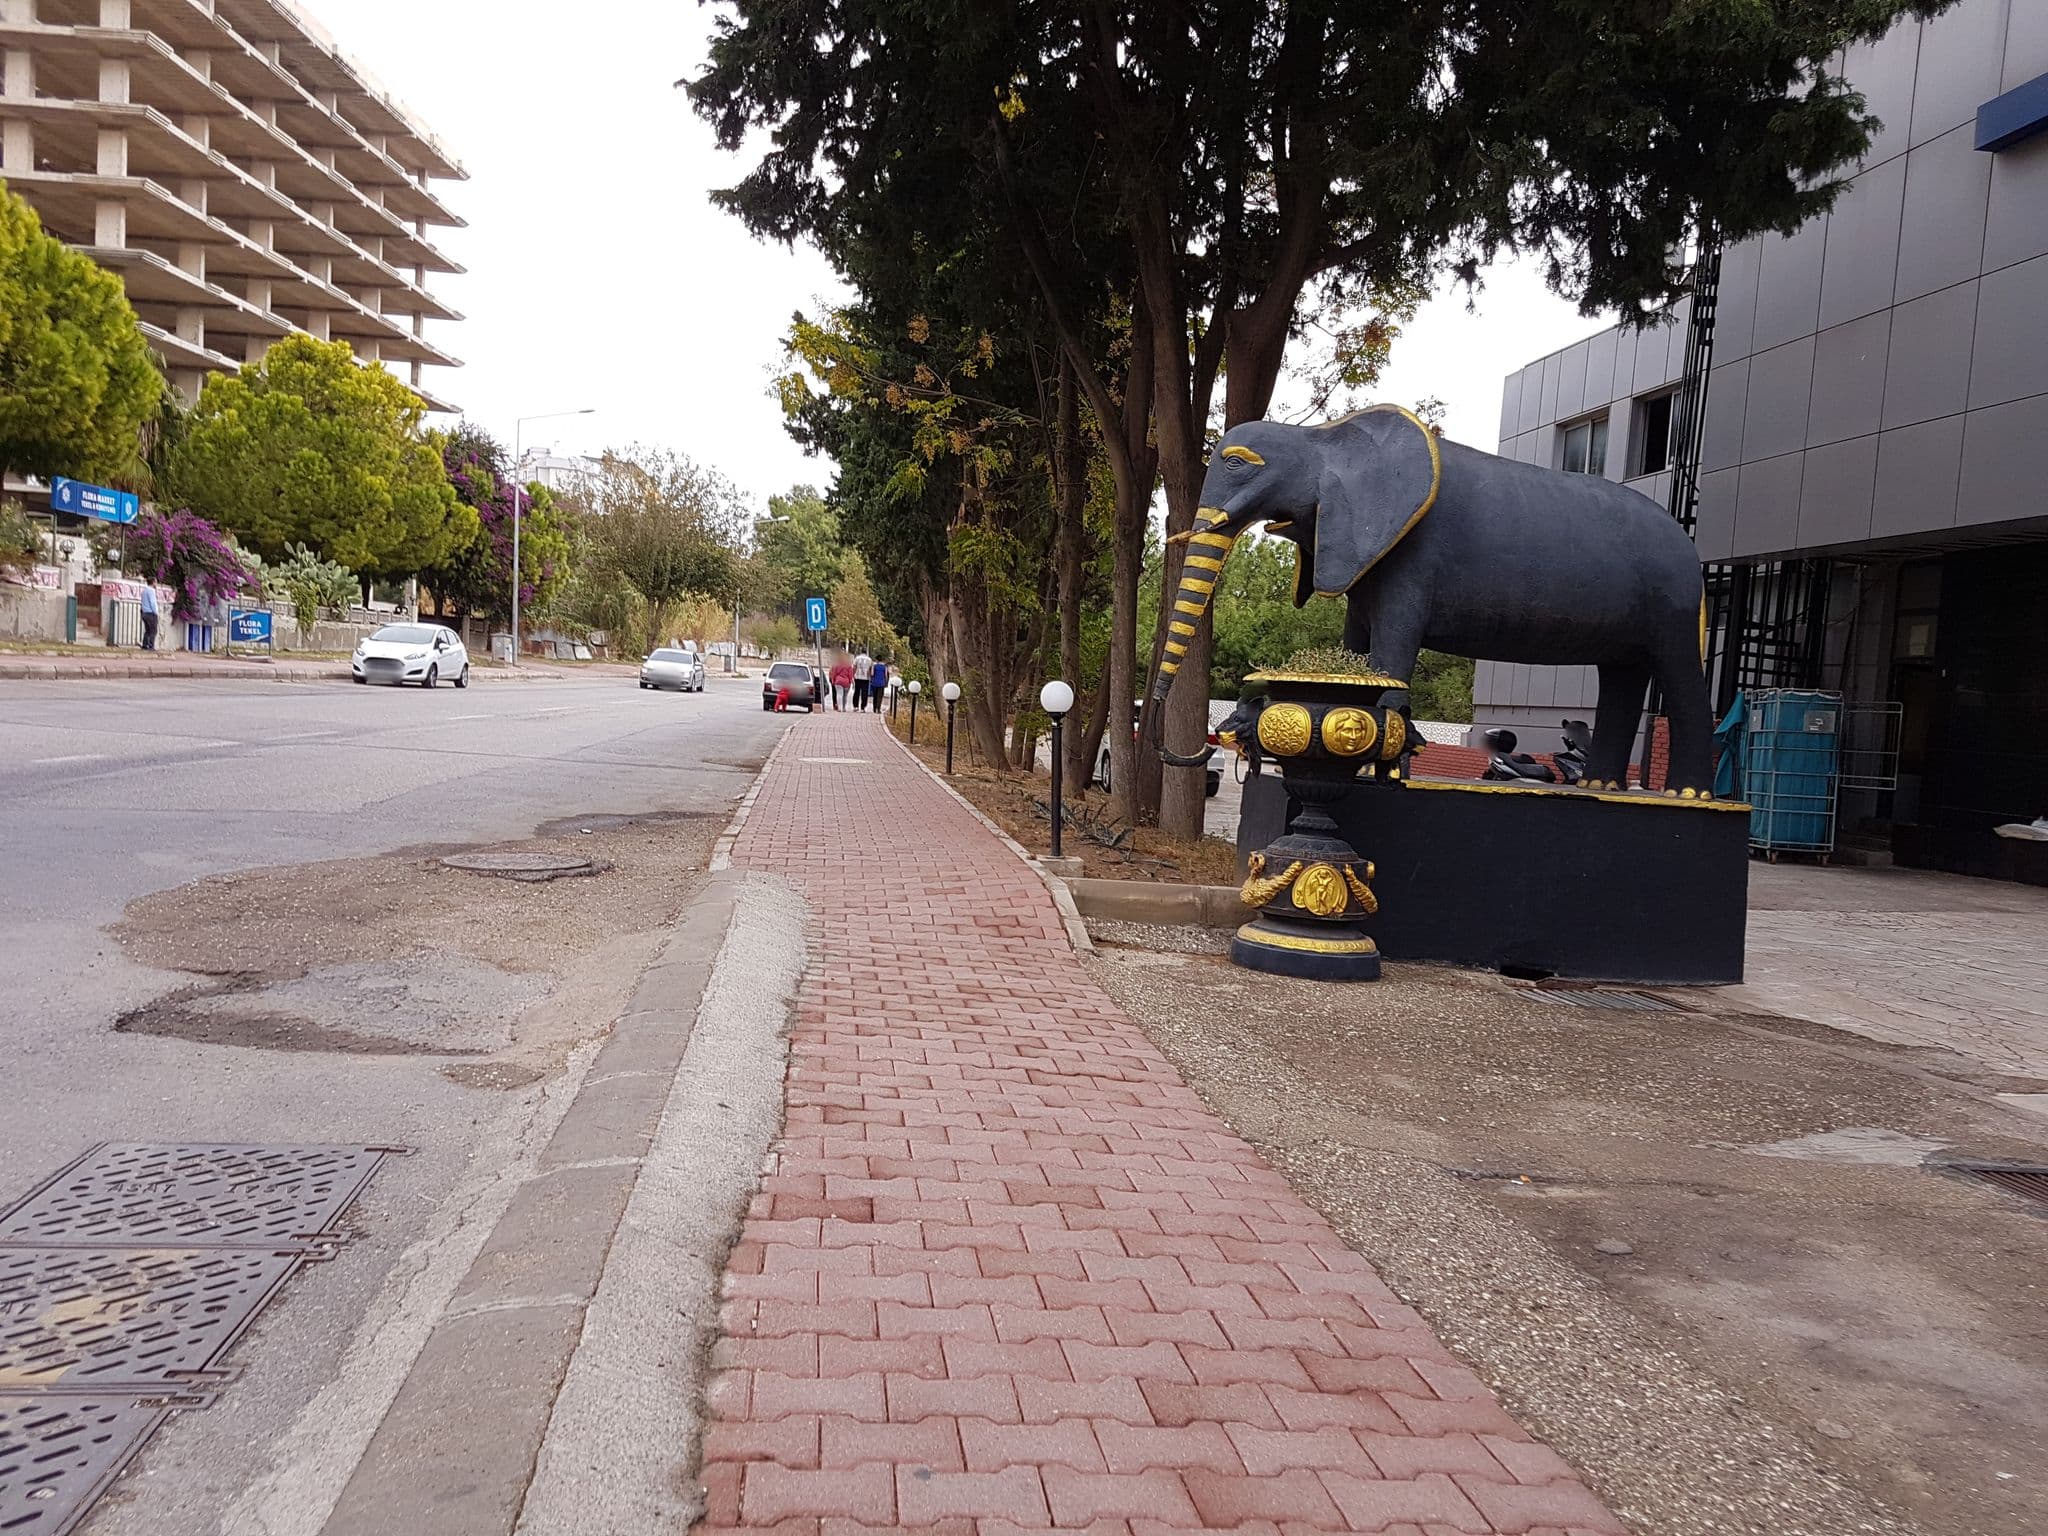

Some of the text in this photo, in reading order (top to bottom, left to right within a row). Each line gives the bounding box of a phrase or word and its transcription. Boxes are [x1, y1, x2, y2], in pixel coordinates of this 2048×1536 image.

[811, 604, 821, 623] D
[239, 620, 262, 628] FLORA
[240, 627, 262, 635] TEKEL
